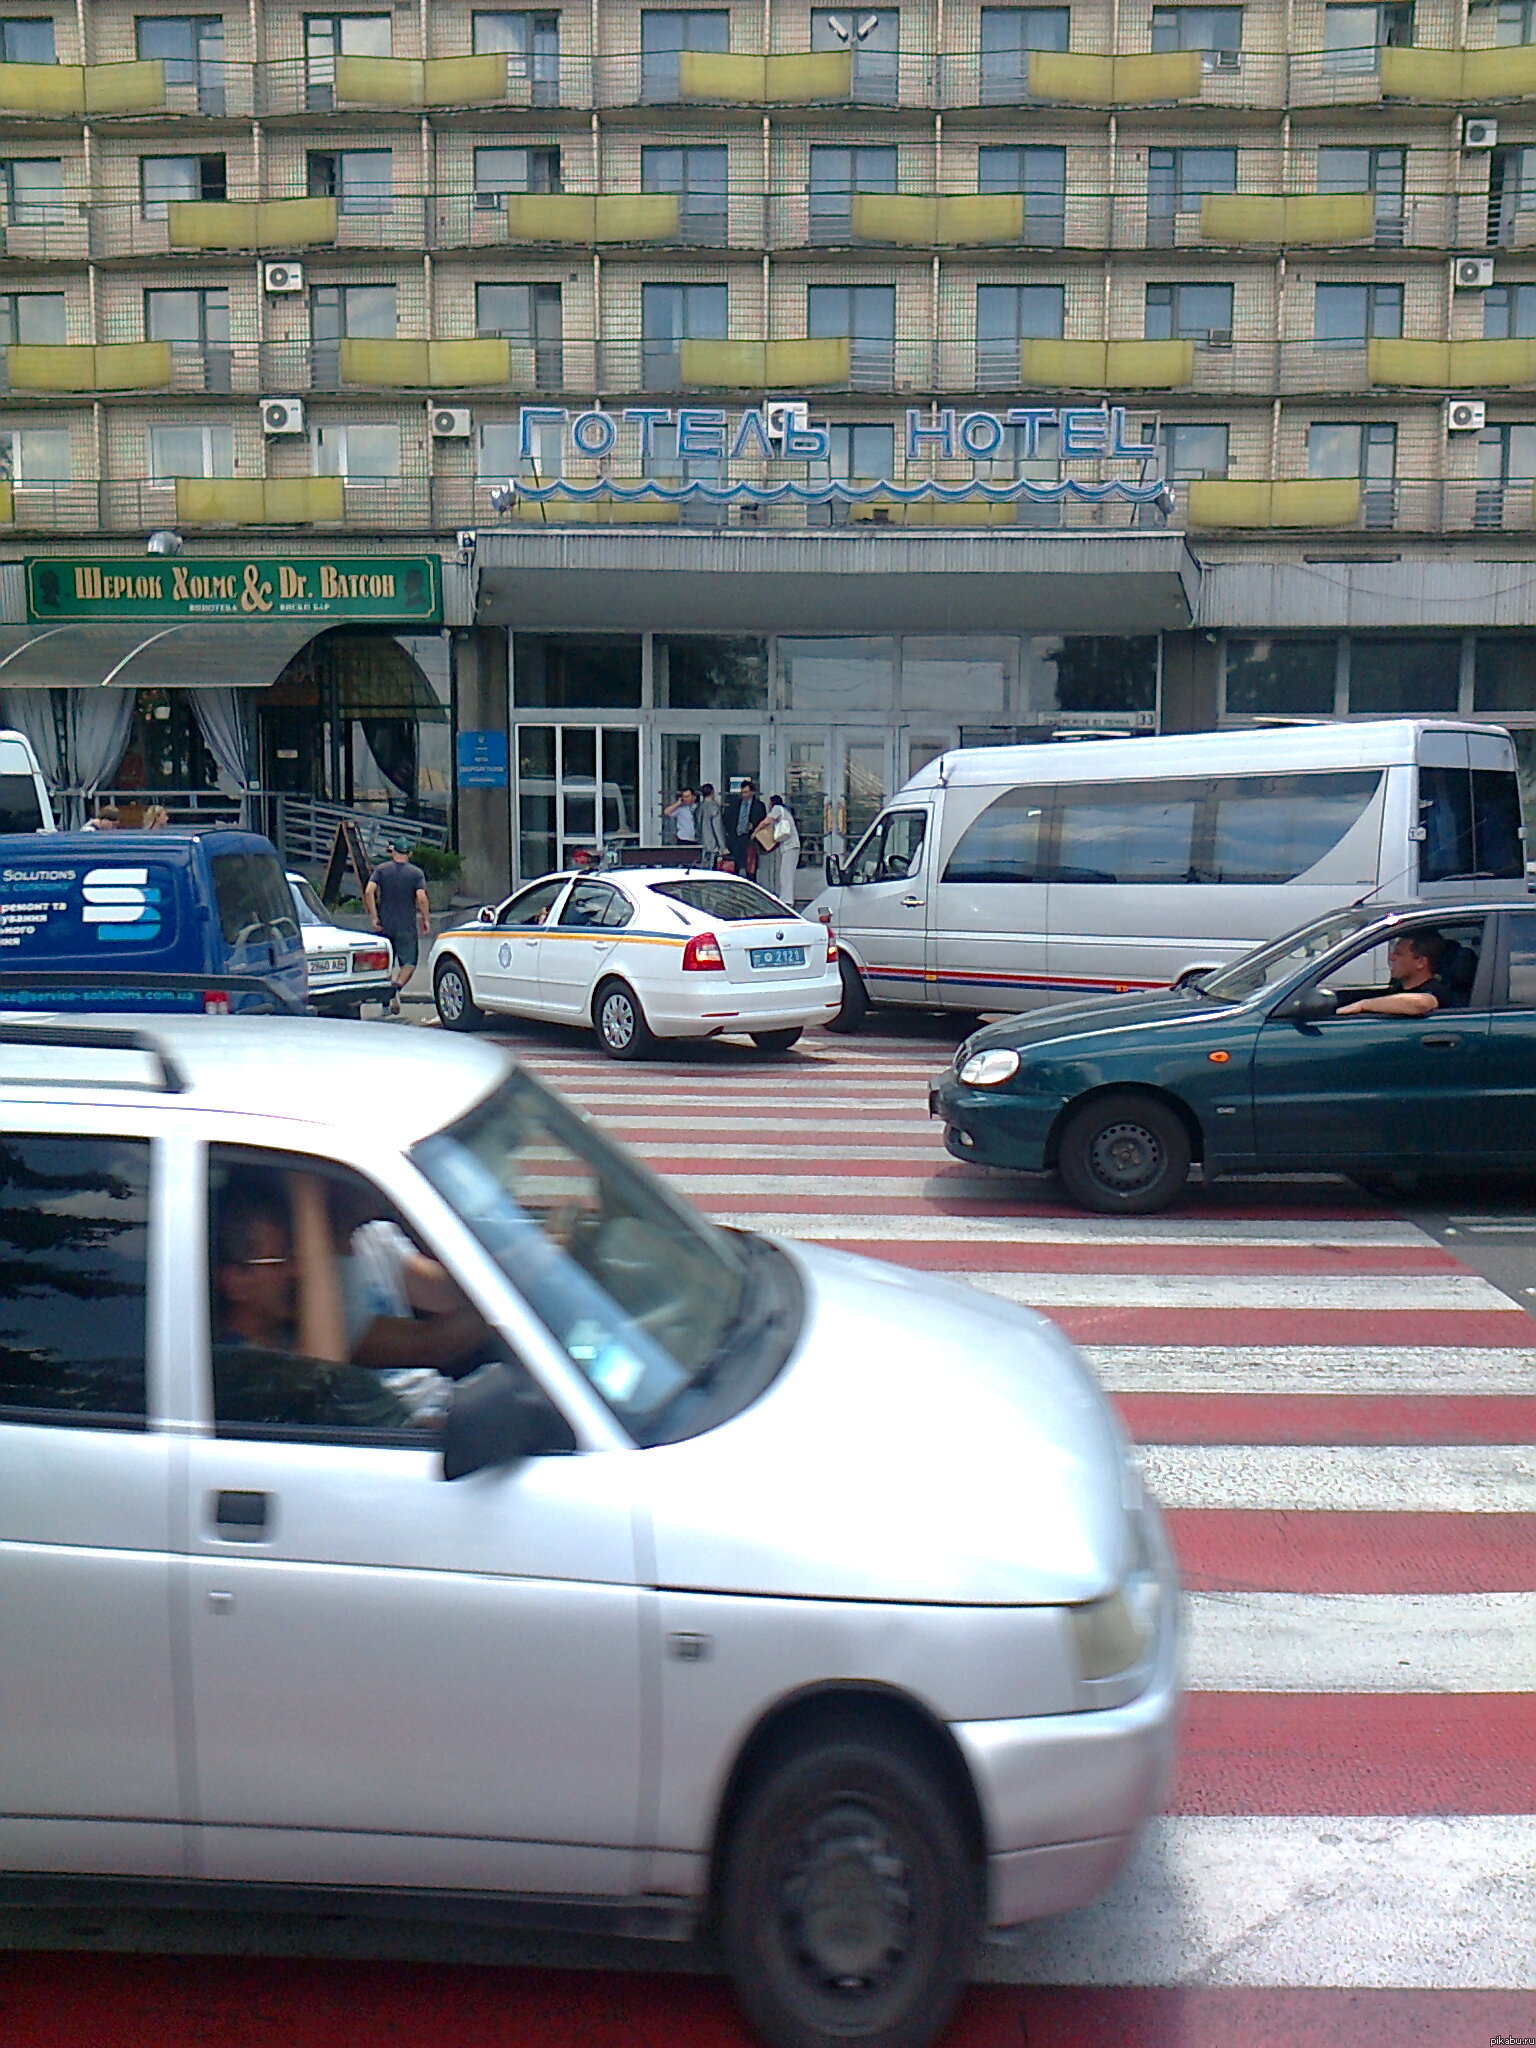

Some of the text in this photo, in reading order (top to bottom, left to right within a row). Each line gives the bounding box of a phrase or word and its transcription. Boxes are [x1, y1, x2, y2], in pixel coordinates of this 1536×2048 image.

[518, 405, 1158, 460] ГОТЕЛЬ HOTEL
[241, 564, 273, 612] &
[279, 566, 313, 598] Dr.
